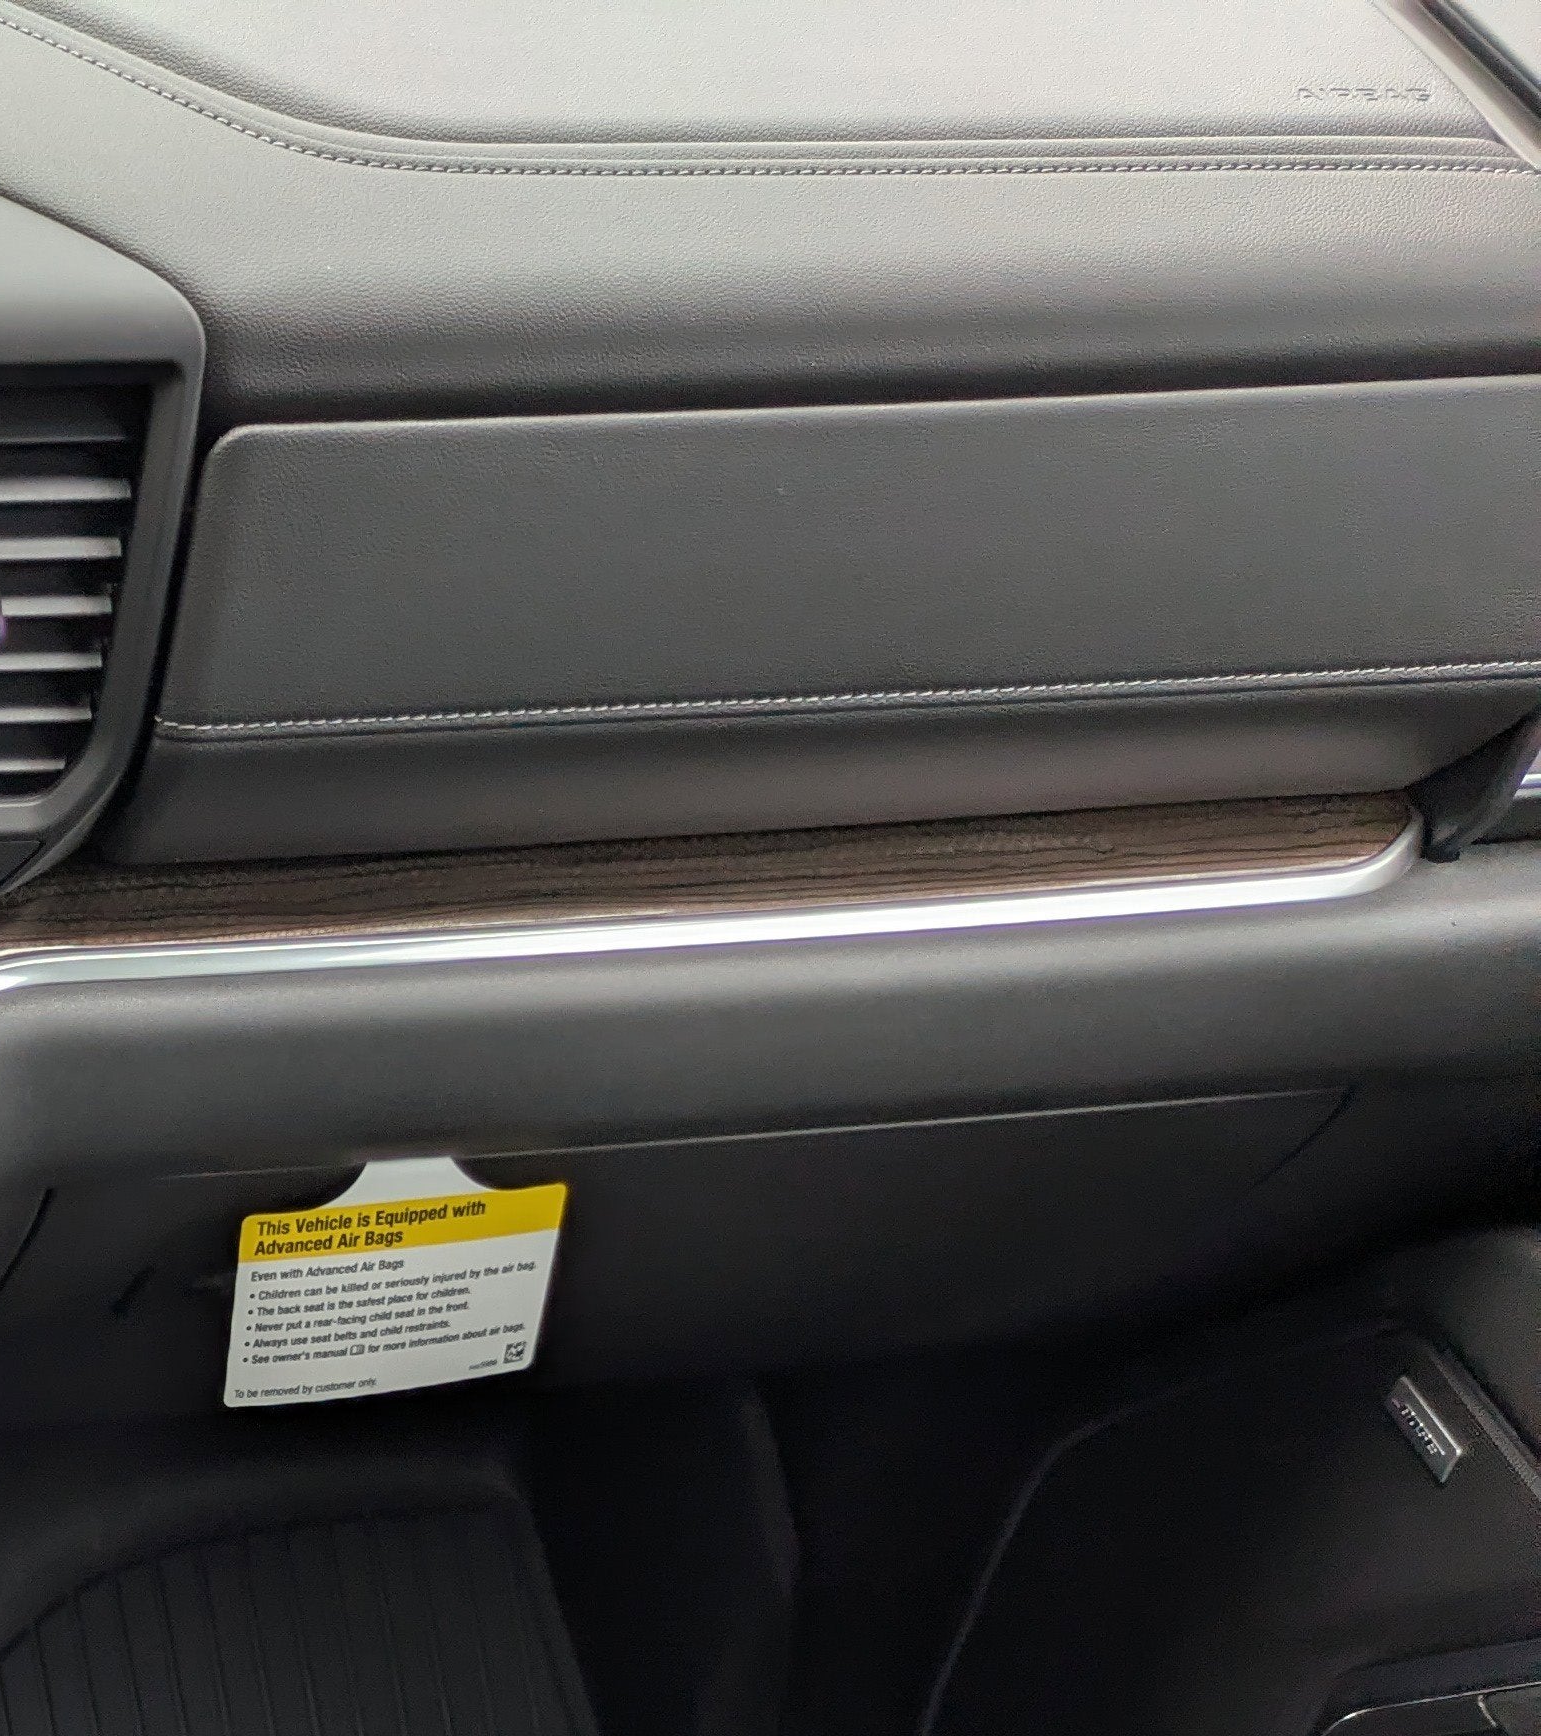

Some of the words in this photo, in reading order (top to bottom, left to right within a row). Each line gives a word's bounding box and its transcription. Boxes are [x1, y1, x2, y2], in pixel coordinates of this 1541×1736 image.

[258, 1220, 290, 1236] This
[296, 1215, 352, 1234] Vehicle
[357, 1213, 370, 1228] is
[375, 1204, 448, 1228] Equipped
[453, 1201, 486, 1218] with
[255, 1235, 333, 1256] Advanced
[337, 1233, 361, 1249] Air
[364, 1230, 404, 1247] Bags
[251, 1271, 276, 1282] Even
[280, 1268, 303, 1280] with
[306, 1263, 358, 1277] Advanced
[360, 1261, 375, 1272] Air
[378, 1260, 404, 1272] Bags
[258, 1288, 301, 1300] Children
[304, 1287, 323, 1297] can
[325, 1285, 338, 1295] be
[341, 1281, 369, 1293] killed
[371, 1281, 382, 1290] or
[385, 1276, 429, 1289] seriously
[432, 1270, 467, 1284] injured
[469, 1269, 481, 1280] by
[483, 1266, 499, 1277] the
[501, 1264, 515, 1274] air
[257, 1306, 275, 1316] The
[277, 1304, 301, 1315] back
[303, 1302, 325, 1313] seat
[327, 1301, 336, 1310] is
[338, 1300, 354, 1310] the
[356, 1296, 386, 1308] safest
[386, 1294, 413, 1306] place
[416, 1291, 429, 1301] for
[254, 1322, 284, 1332] Never
[285, 1320, 303, 1332] put
[304, 1320, 311, 1328] a
[313, 1314, 367, 1328] rear-facing
[369, 1311, 392, 1323] child
[394, 1308, 415, 1319] seat
[417, 1307, 426, 1316] in
[428, 1305, 443, 1315] the
[252, 1353, 270, 1364] See
[272, 1351, 311, 1362] owner's
[313, 1348, 348, 1359] manual
[368, 1344, 380, 1353] for
[382, 1341, 406, 1352] more
[408, 1333, 460, 1348] information
[462, 1328, 487, 1340] about
[488, 1327, 501, 1336] air
[253, 1337, 288, 1349] Always
[291, 1336, 308, 1345] use
[310, 1333, 331, 1344] seat
[334, 1331, 357, 1341] belts
[359, 1328, 378, 1338] and
[380, 1325, 403, 1336] child
[234, 1389, 244, 1398] To
[247, 1388, 258, 1398] be
[260, 1385, 300, 1397] removed
[302, 1384, 314, 1395] by
[315, 1380, 356, 1393] customer
